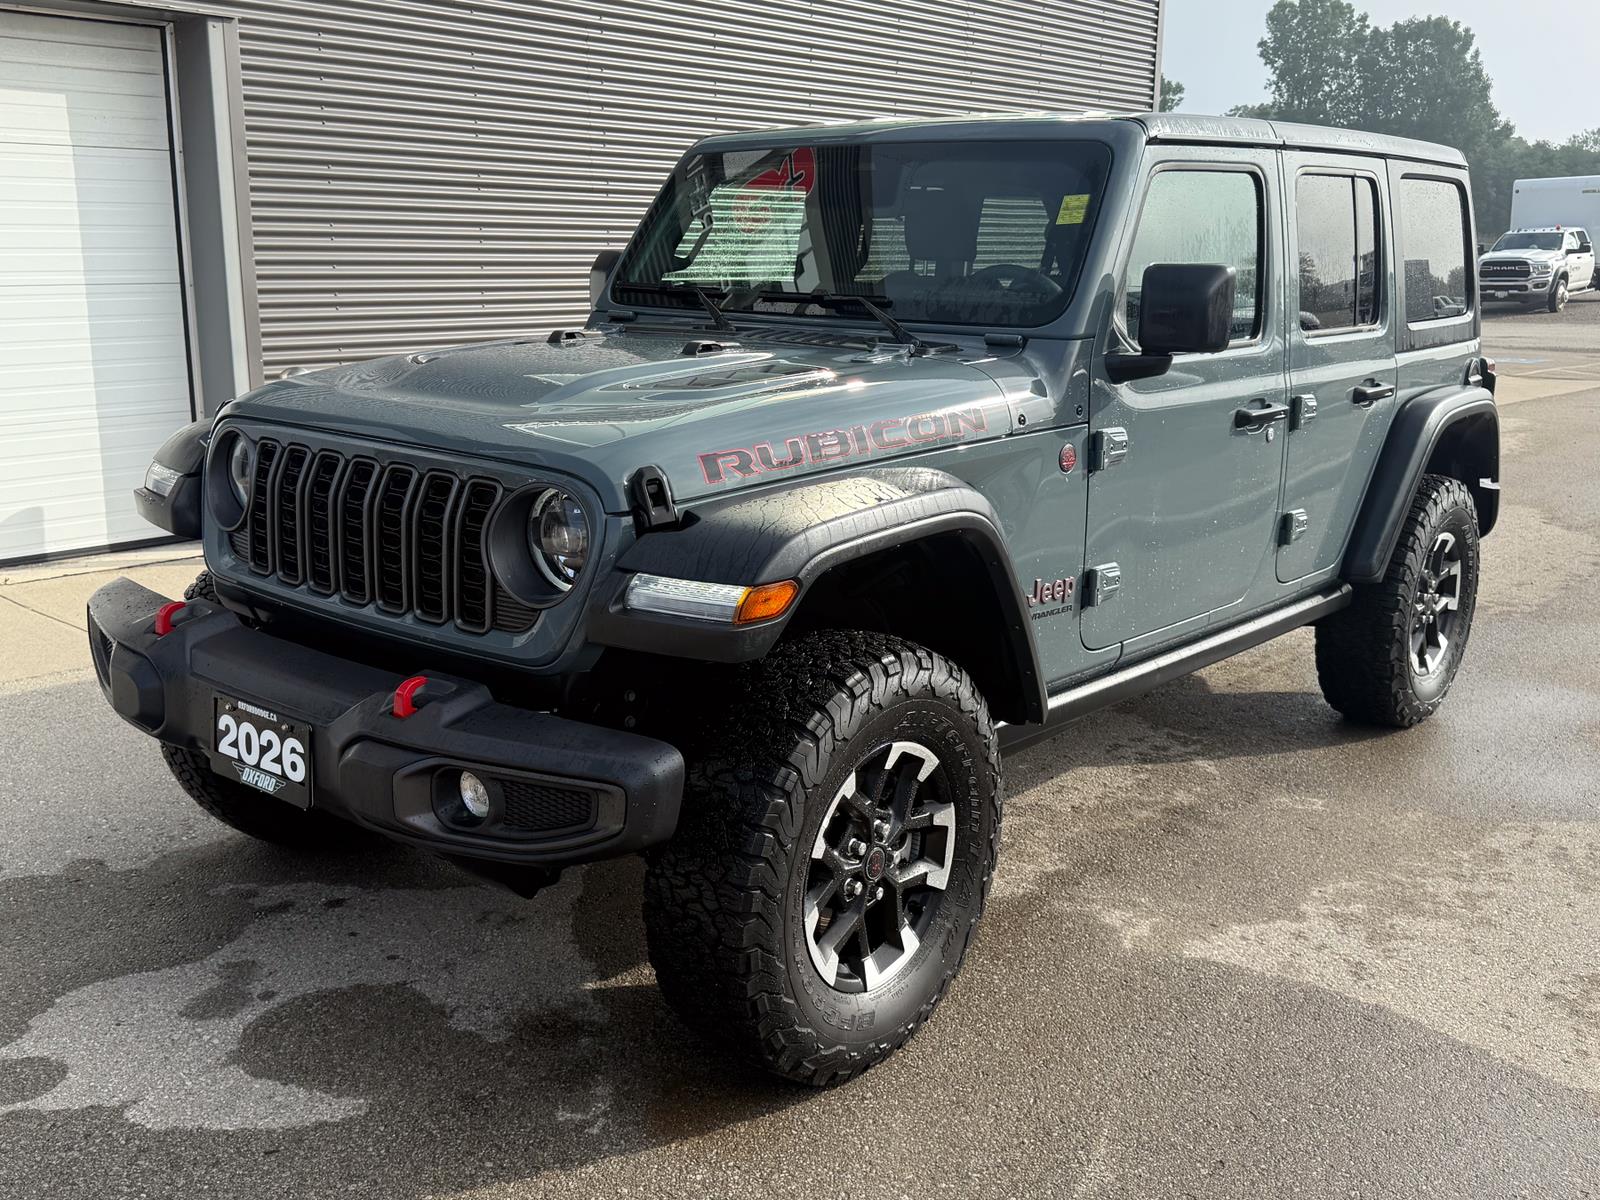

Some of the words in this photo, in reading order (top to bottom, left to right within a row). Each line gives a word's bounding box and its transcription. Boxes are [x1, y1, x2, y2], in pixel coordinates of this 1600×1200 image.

[698, 406, 989, 484] RUBICON
[1025, 575, 1075, 608] Jeep
[218, 714, 306, 783] 2026
[242, 767, 277, 792] OXFORD
